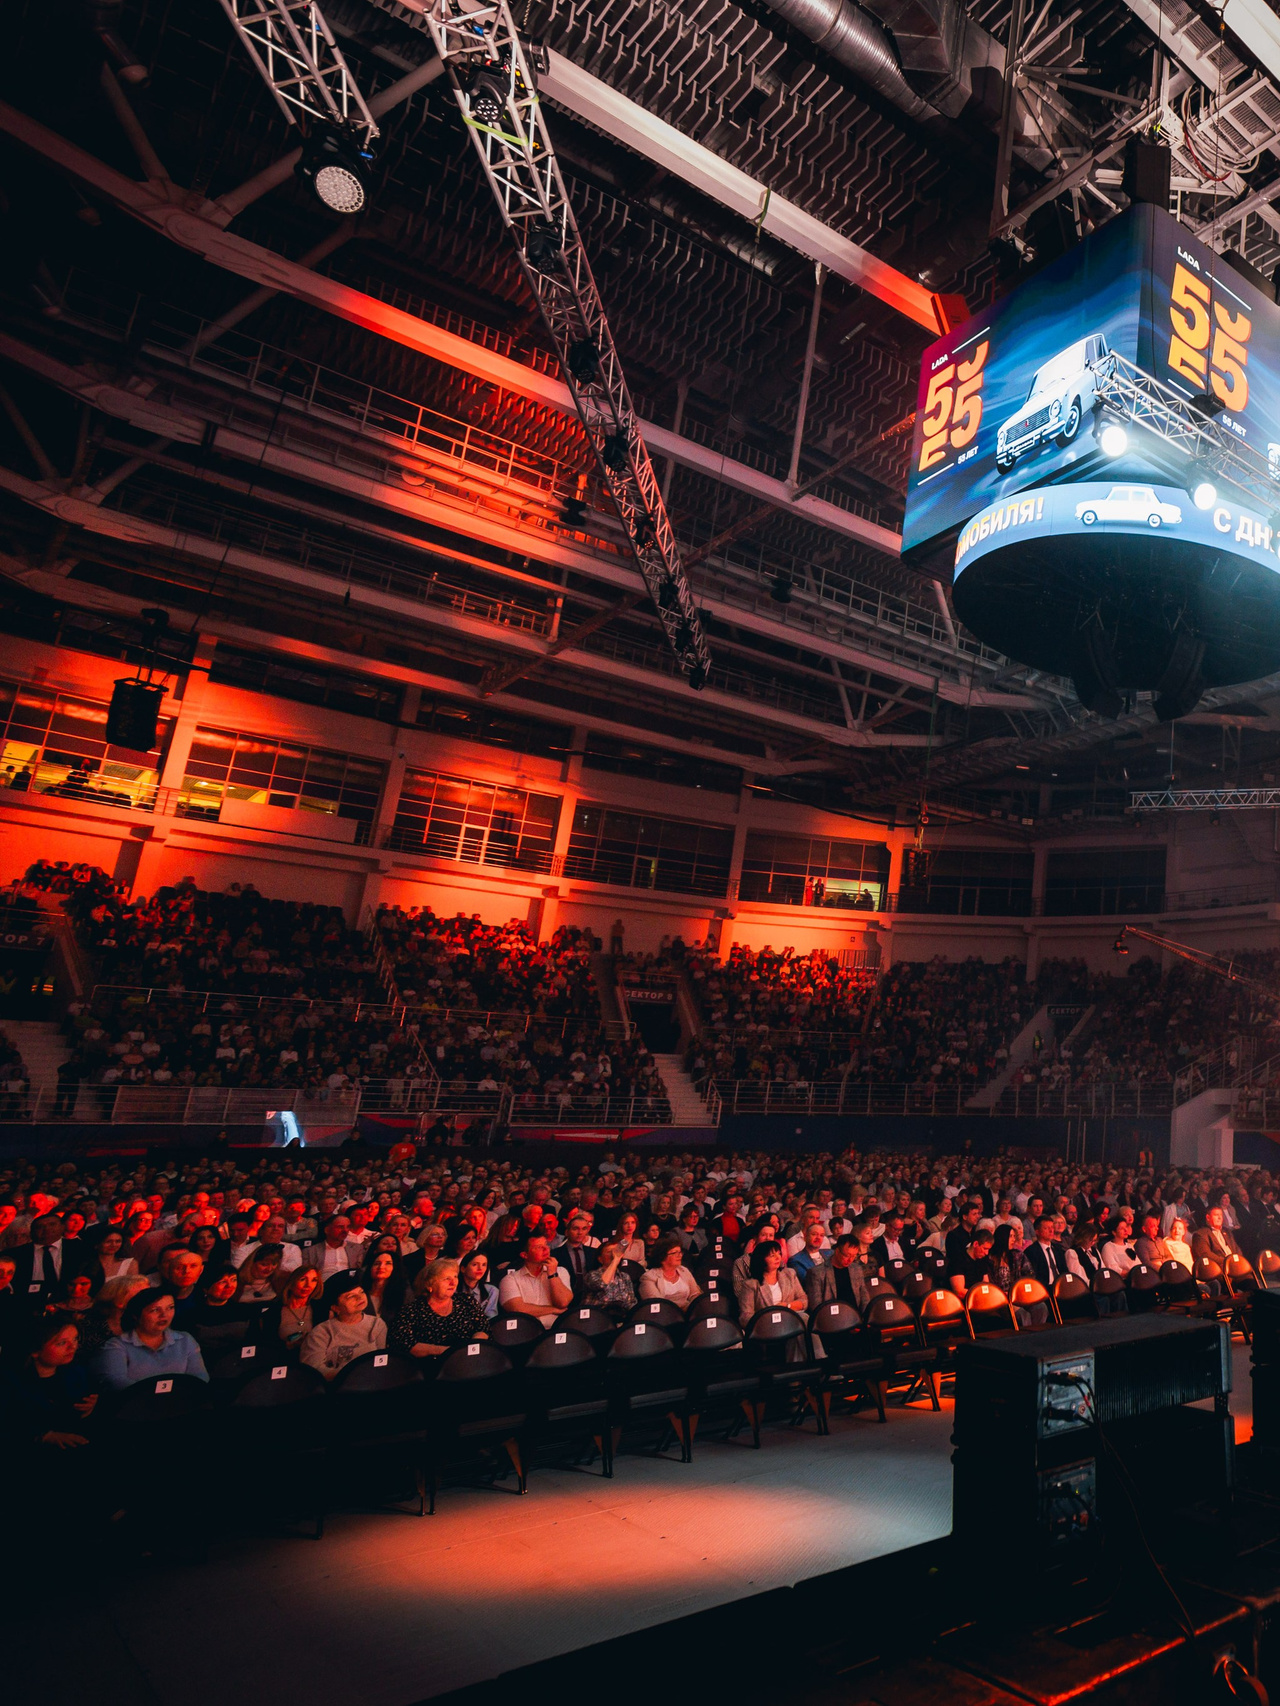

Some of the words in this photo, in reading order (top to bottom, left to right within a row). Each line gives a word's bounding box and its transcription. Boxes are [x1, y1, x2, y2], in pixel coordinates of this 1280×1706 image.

[1177, 246, 1200, 271] LADA
[931, 354, 948, 370] LADA
[1222, 414, 1232, 428] 55
[1231, 421, 1246, 437] ЛЕТ
[966, 446, 979, 461] ЛЕТ
[1213, 508, 1232, 533] С
[0, 933, 29, 944] ОР
[36, 937, 45, 946] 7
[624, 990, 664, 1000] СЕКТОР
[161, 1382, 167, 1390] 3
